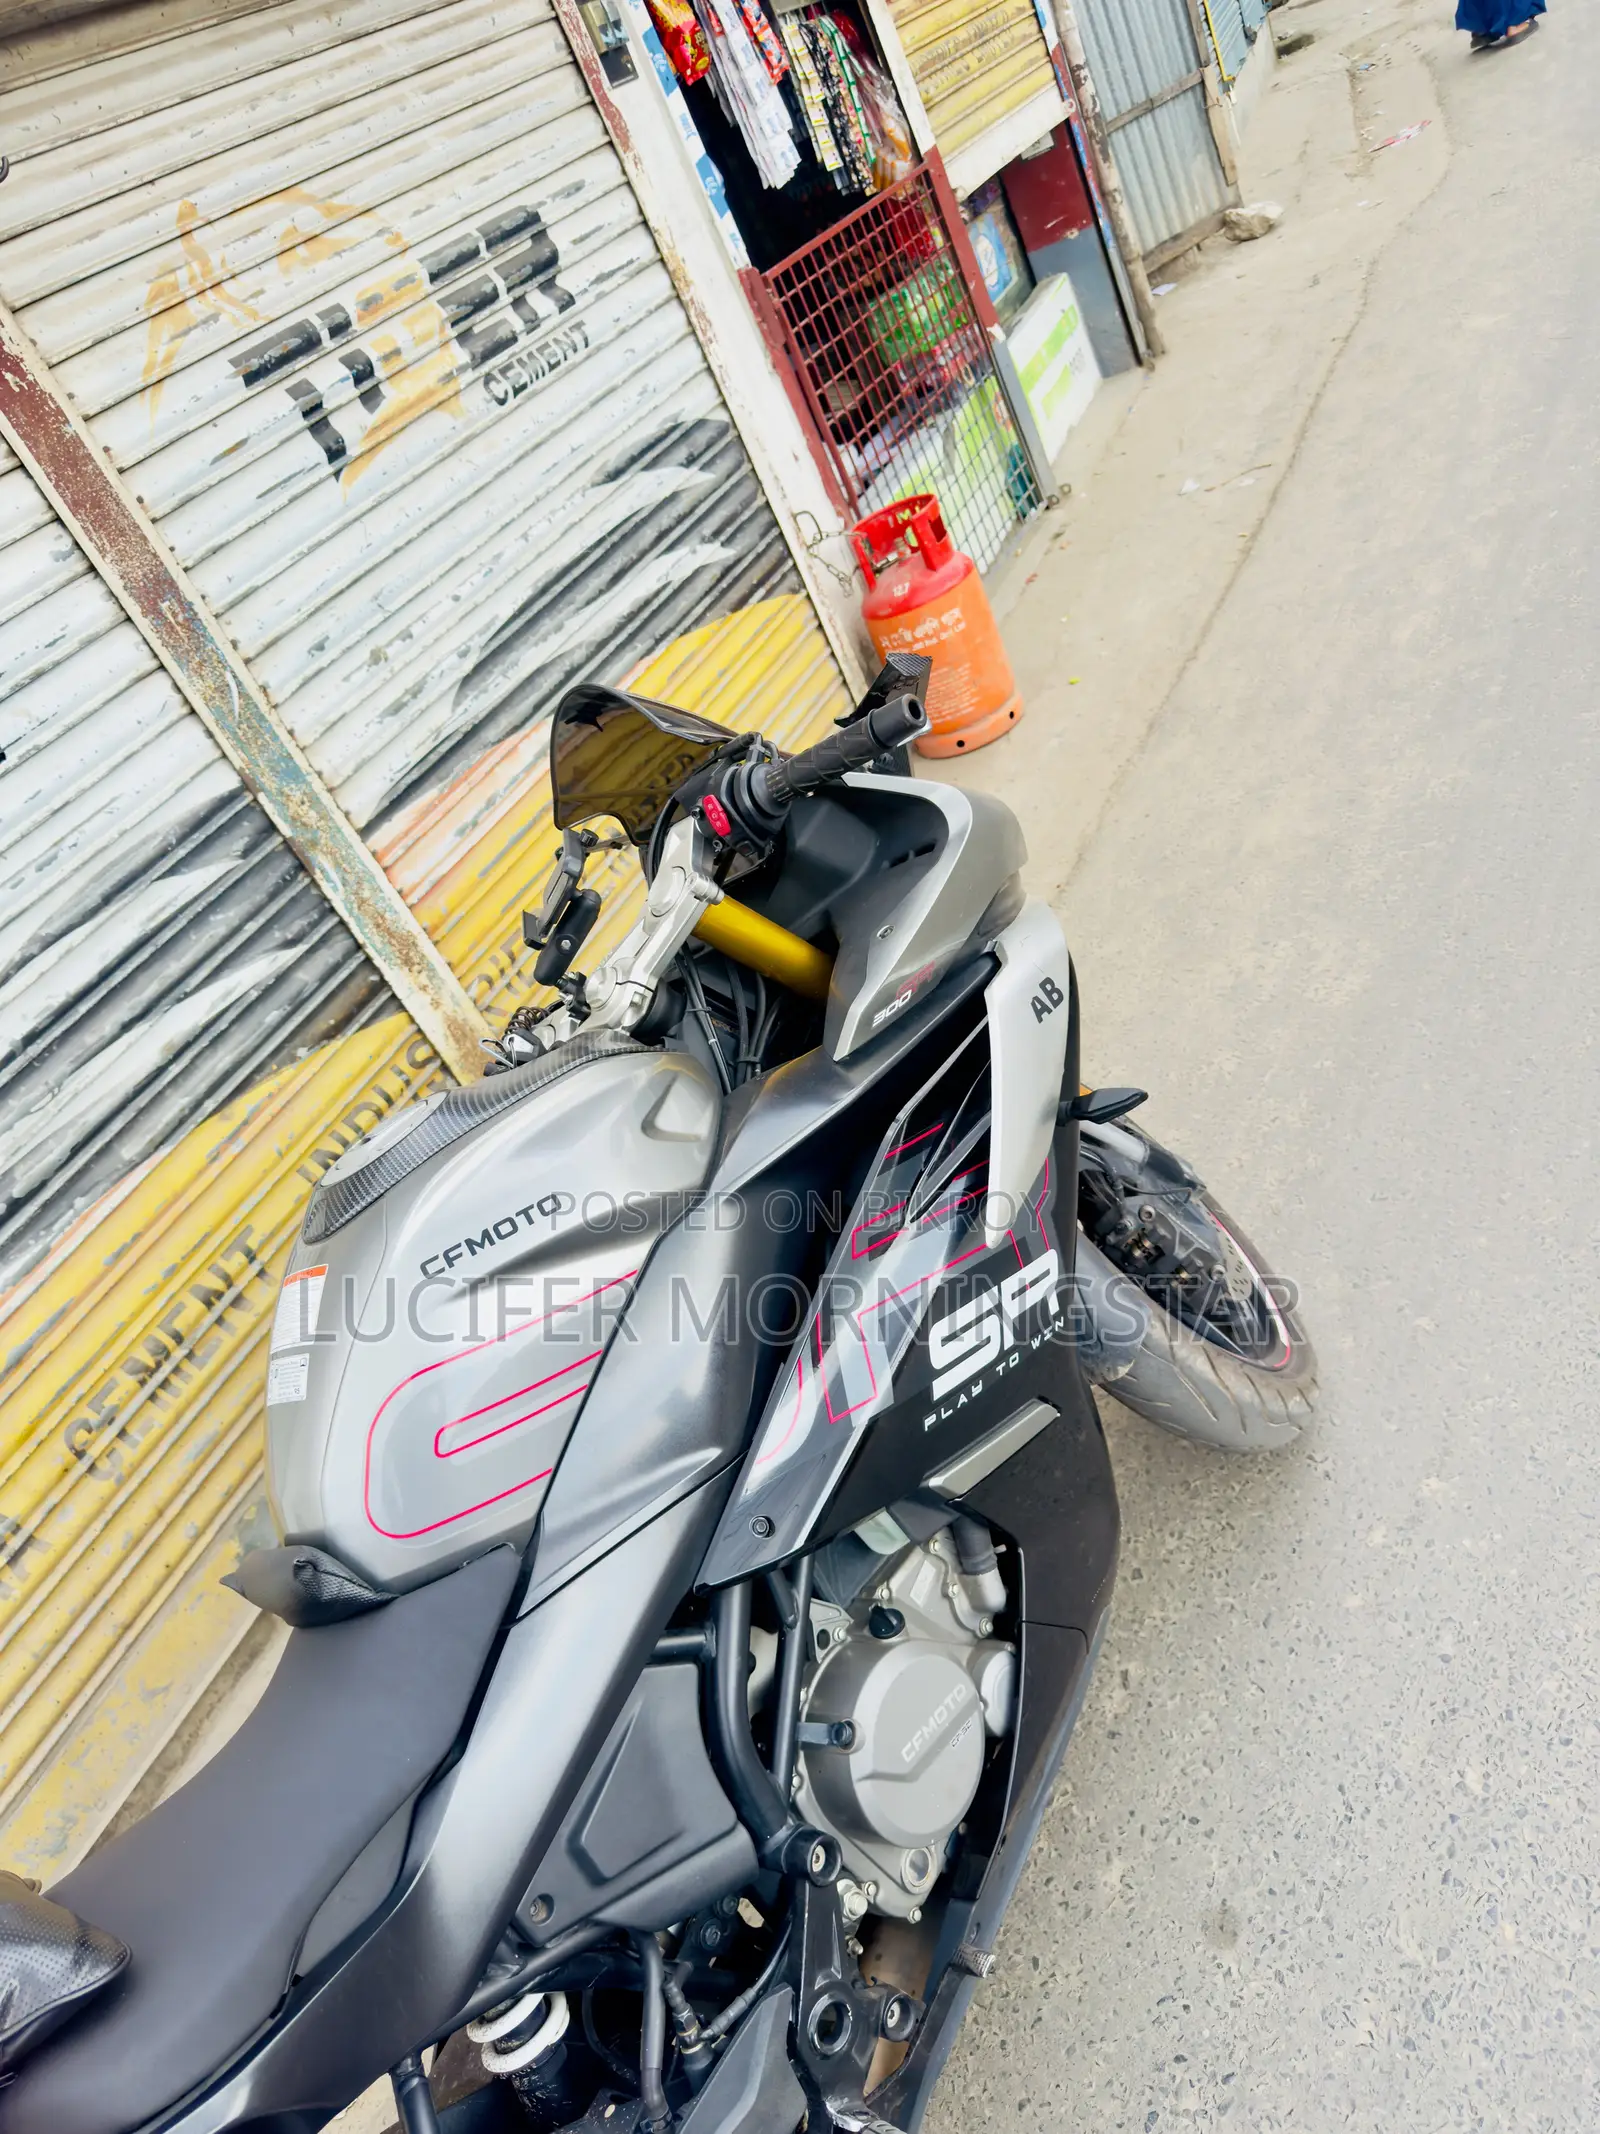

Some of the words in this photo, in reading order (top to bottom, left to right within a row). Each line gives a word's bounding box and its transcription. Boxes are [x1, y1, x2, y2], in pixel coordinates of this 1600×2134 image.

[228, 204, 576, 482] TIGER
[484, 320, 590, 406] CEMENT
[872, 989, 912, 1029] 300
[1031, 976, 1064, 1024] AB
[420, 1193, 562, 1279] CFMOTO
[63, 1224, 278, 1486] CEMENT
[929, 1249, 1060, 1401] SR
[924, 1380, 983, 1432] PLAY
[996, 1352, 1020, 1376] TO
[1030, 1316, 1065, 1350] WIN
[901, 1683, 966, 1763] CFMOTO
